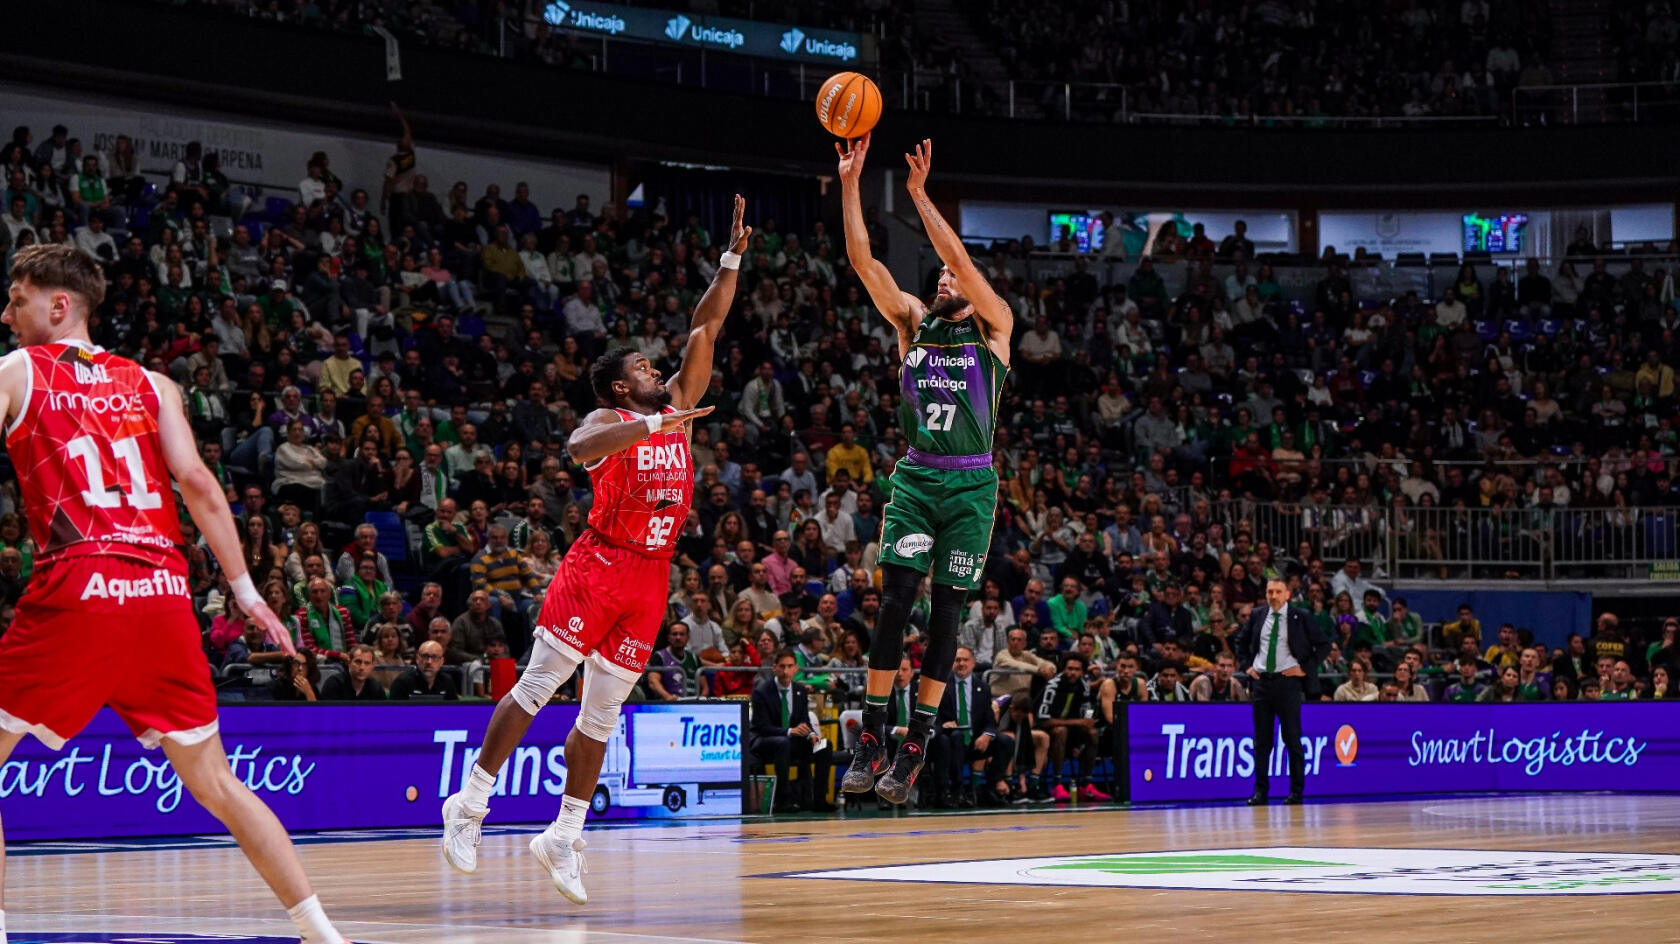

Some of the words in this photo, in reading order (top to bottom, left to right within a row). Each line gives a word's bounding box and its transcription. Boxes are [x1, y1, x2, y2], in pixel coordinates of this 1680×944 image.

[691, 26, 744, 49] Unicaja
[805, 39, 857, 61] Unicaja
[93, 132, 117, 152] JOS
[74, 361, 112, 385] UBAL
[928, 354, 976, 370] Unicaja
[918, 375, 967, 392] málaga
[926, 402, 957, 432] 27
[637, 443, 687, 471] BAXI
[67, 435, 162, 509] 11
[646, 516, 675, 546] 32
[949, 562, 973, 578] laga
[953, 554, 974, 567] má
[80, 569, 191, 605] Aquaflix
[552, 624, 585, 649] unilabor
[618, 643, 637, 659] ETL
[680, 717, 741, 747] Trans
[1162, 723, 1328, 779] Transher
[1408, 730, 1486, 767] Smart
[1487, 728, 1647, 776] Logistics
[0, 745, 95, 798] art
[97, 743, 316, 813] Logtics
